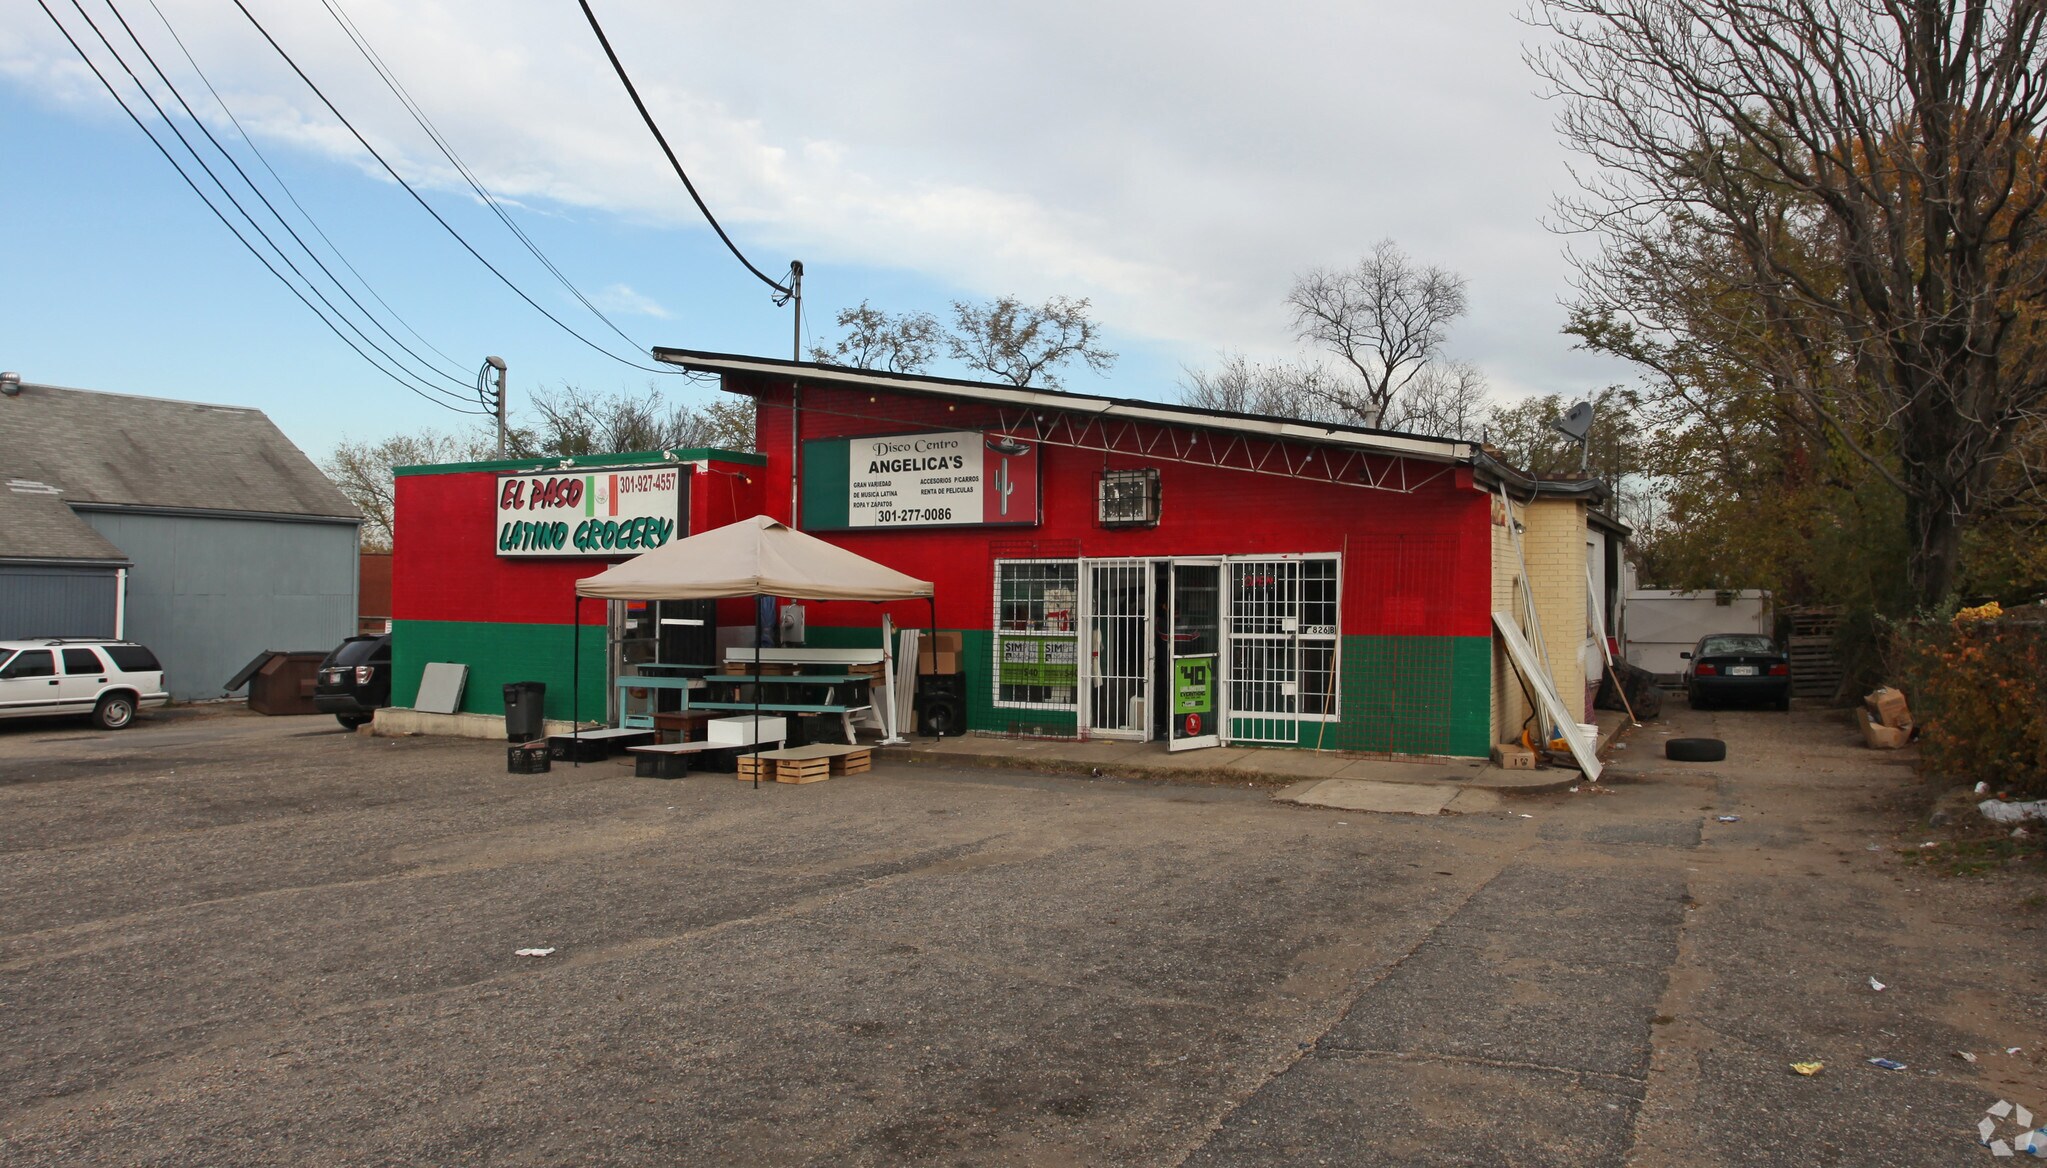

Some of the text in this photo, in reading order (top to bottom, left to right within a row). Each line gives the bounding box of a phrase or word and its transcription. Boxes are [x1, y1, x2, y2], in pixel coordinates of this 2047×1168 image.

[872, 439, 959, 456] Disco Centro
[868, 455, 963, 474] ANGELICA'S
[619, 472, 677, 494] 301-927-4557
[868, 480, 892, 488] VARIEDAD
[920, 477, 952, 485] ACCESORIOS
[500, 477, 584, 511] EL PASO
[945, 486, 974, 494] PELICULAS
[878, 507, 952, 522] 301-277-0086
[499, 516, 674, 553] LATINO GROCERY
